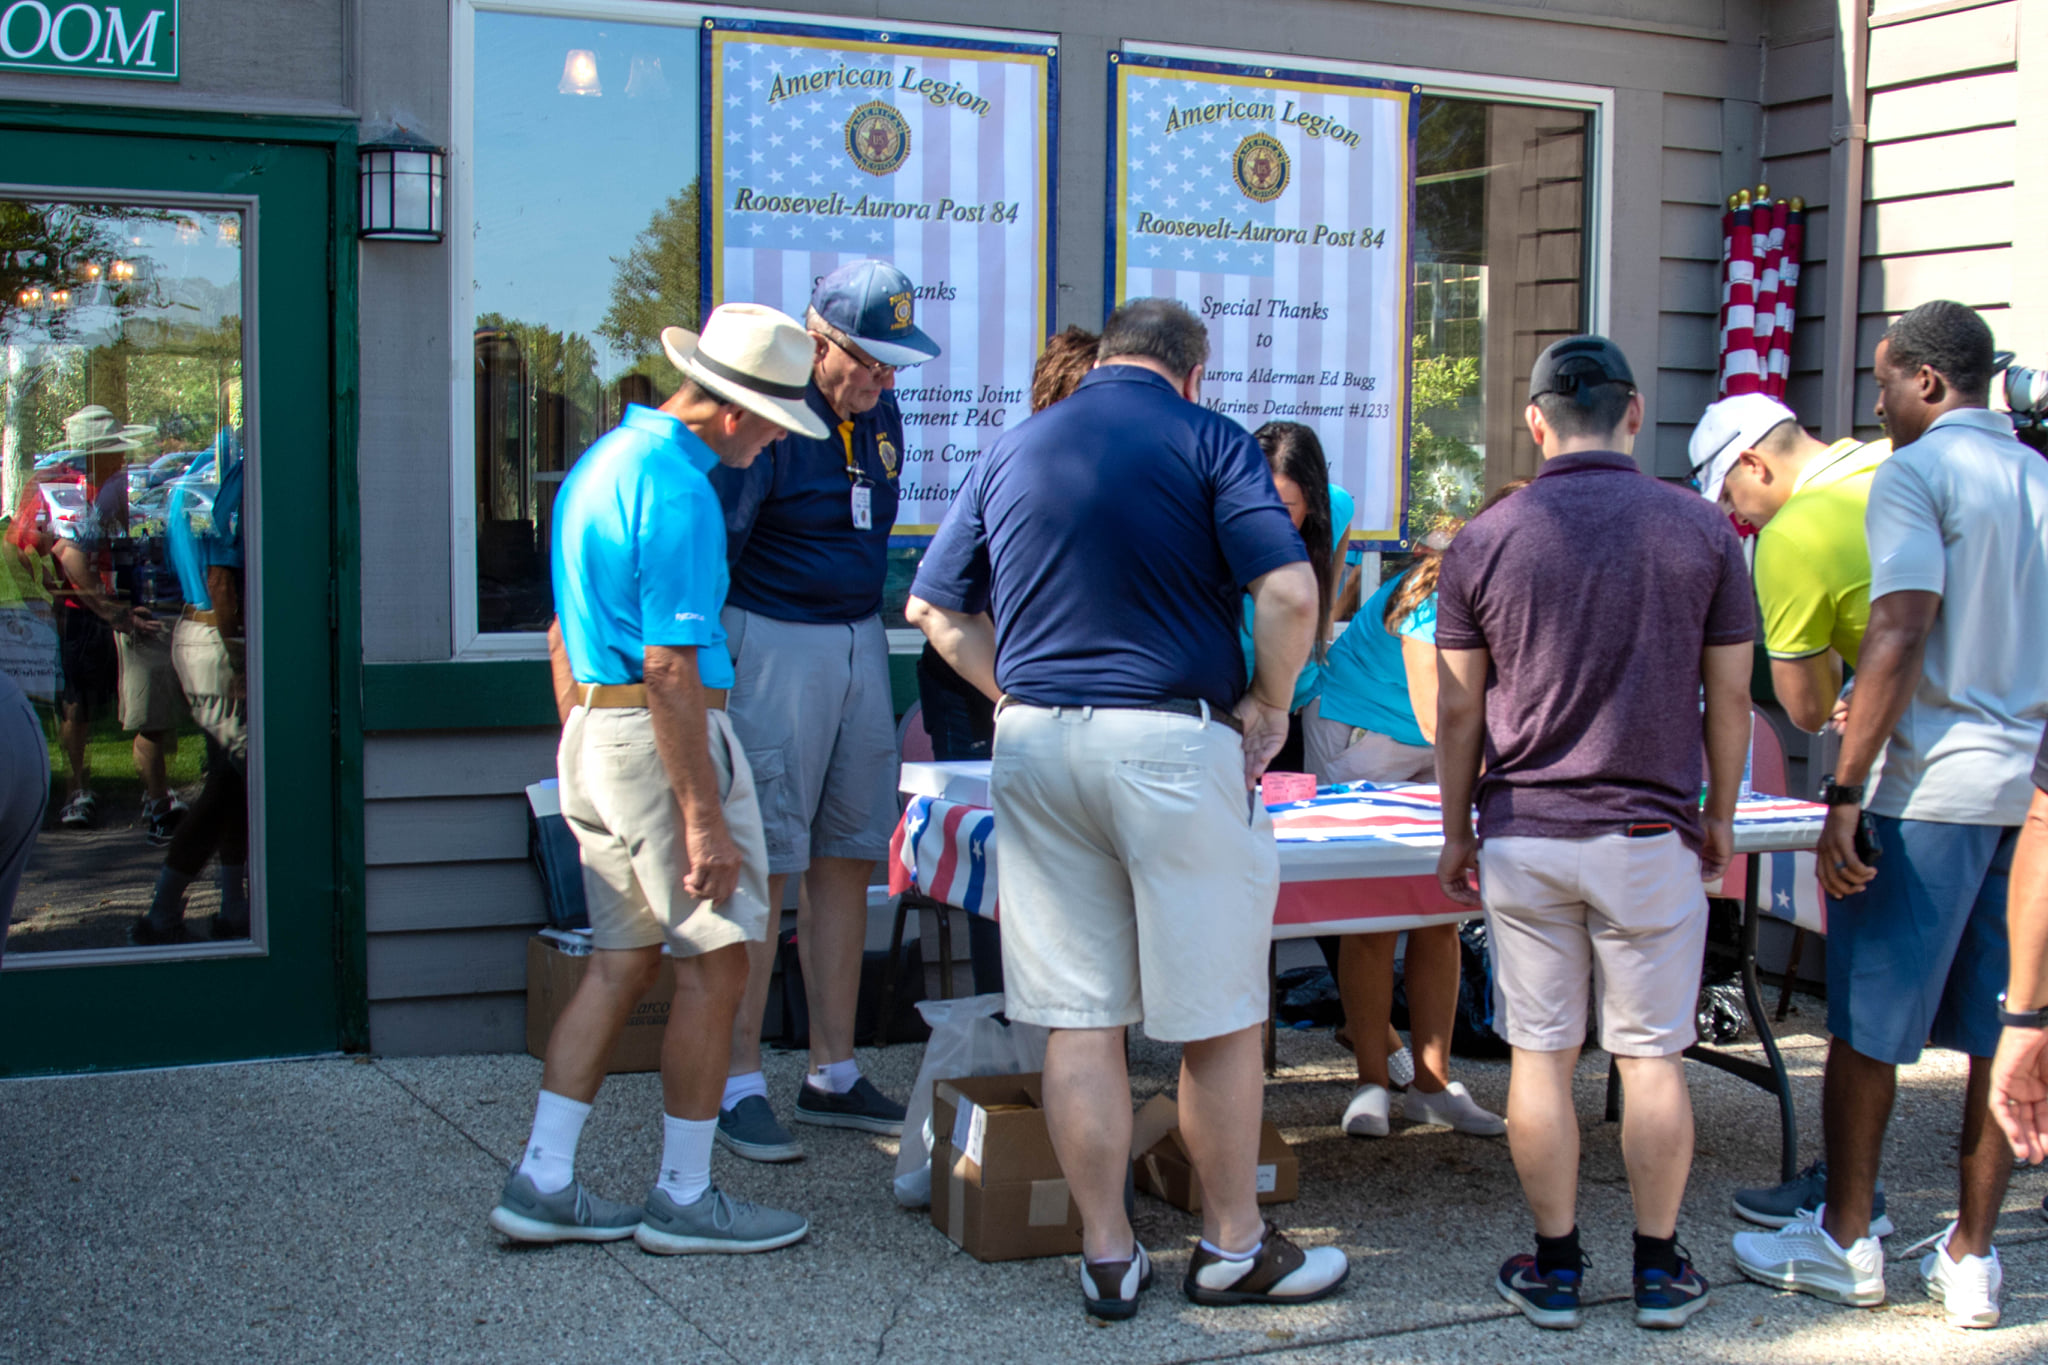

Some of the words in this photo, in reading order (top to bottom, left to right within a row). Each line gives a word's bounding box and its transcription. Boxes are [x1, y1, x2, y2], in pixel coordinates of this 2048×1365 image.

[768, 63, 893, 103] American
[899, 66, 991, 117] Legion
[1164, 98, 1275, 133] American
[1281, 100, 1361, 149] Legion
[734, 188, 930, 221] Roosevelt-Aurora
[936, 198, 985, 223] Post
[990, 201, 1019, 224] 84
[1137, 212, 1307, 244] Roosevelt-Aurora
[1312, 225, 1355, 247] Post
[1360, 228, 1386, 249] 84
[914, 280, 956, 301] anks
[1202, 296, 1260, 319] Special
[1267, 299, 1329, 320] Thanks
[1256, 332, 1272, 348] to
[1247, 368, 1314, 385] Alderman
[1320, 371, 1339, 386] Ed
[1342, 372, 1376, 391] Bugg
[894, 384, 973, 403] perations
[978, 385, 1022, 403] Joint
[963, 408, 1006, 427] PAC
[1205, 398, 1258, 415] Marines
[1262, 400, 1344, 417] Detachment
[1349, 403, 1389, 418] #1233
[941, 444, 982, 462] Com
